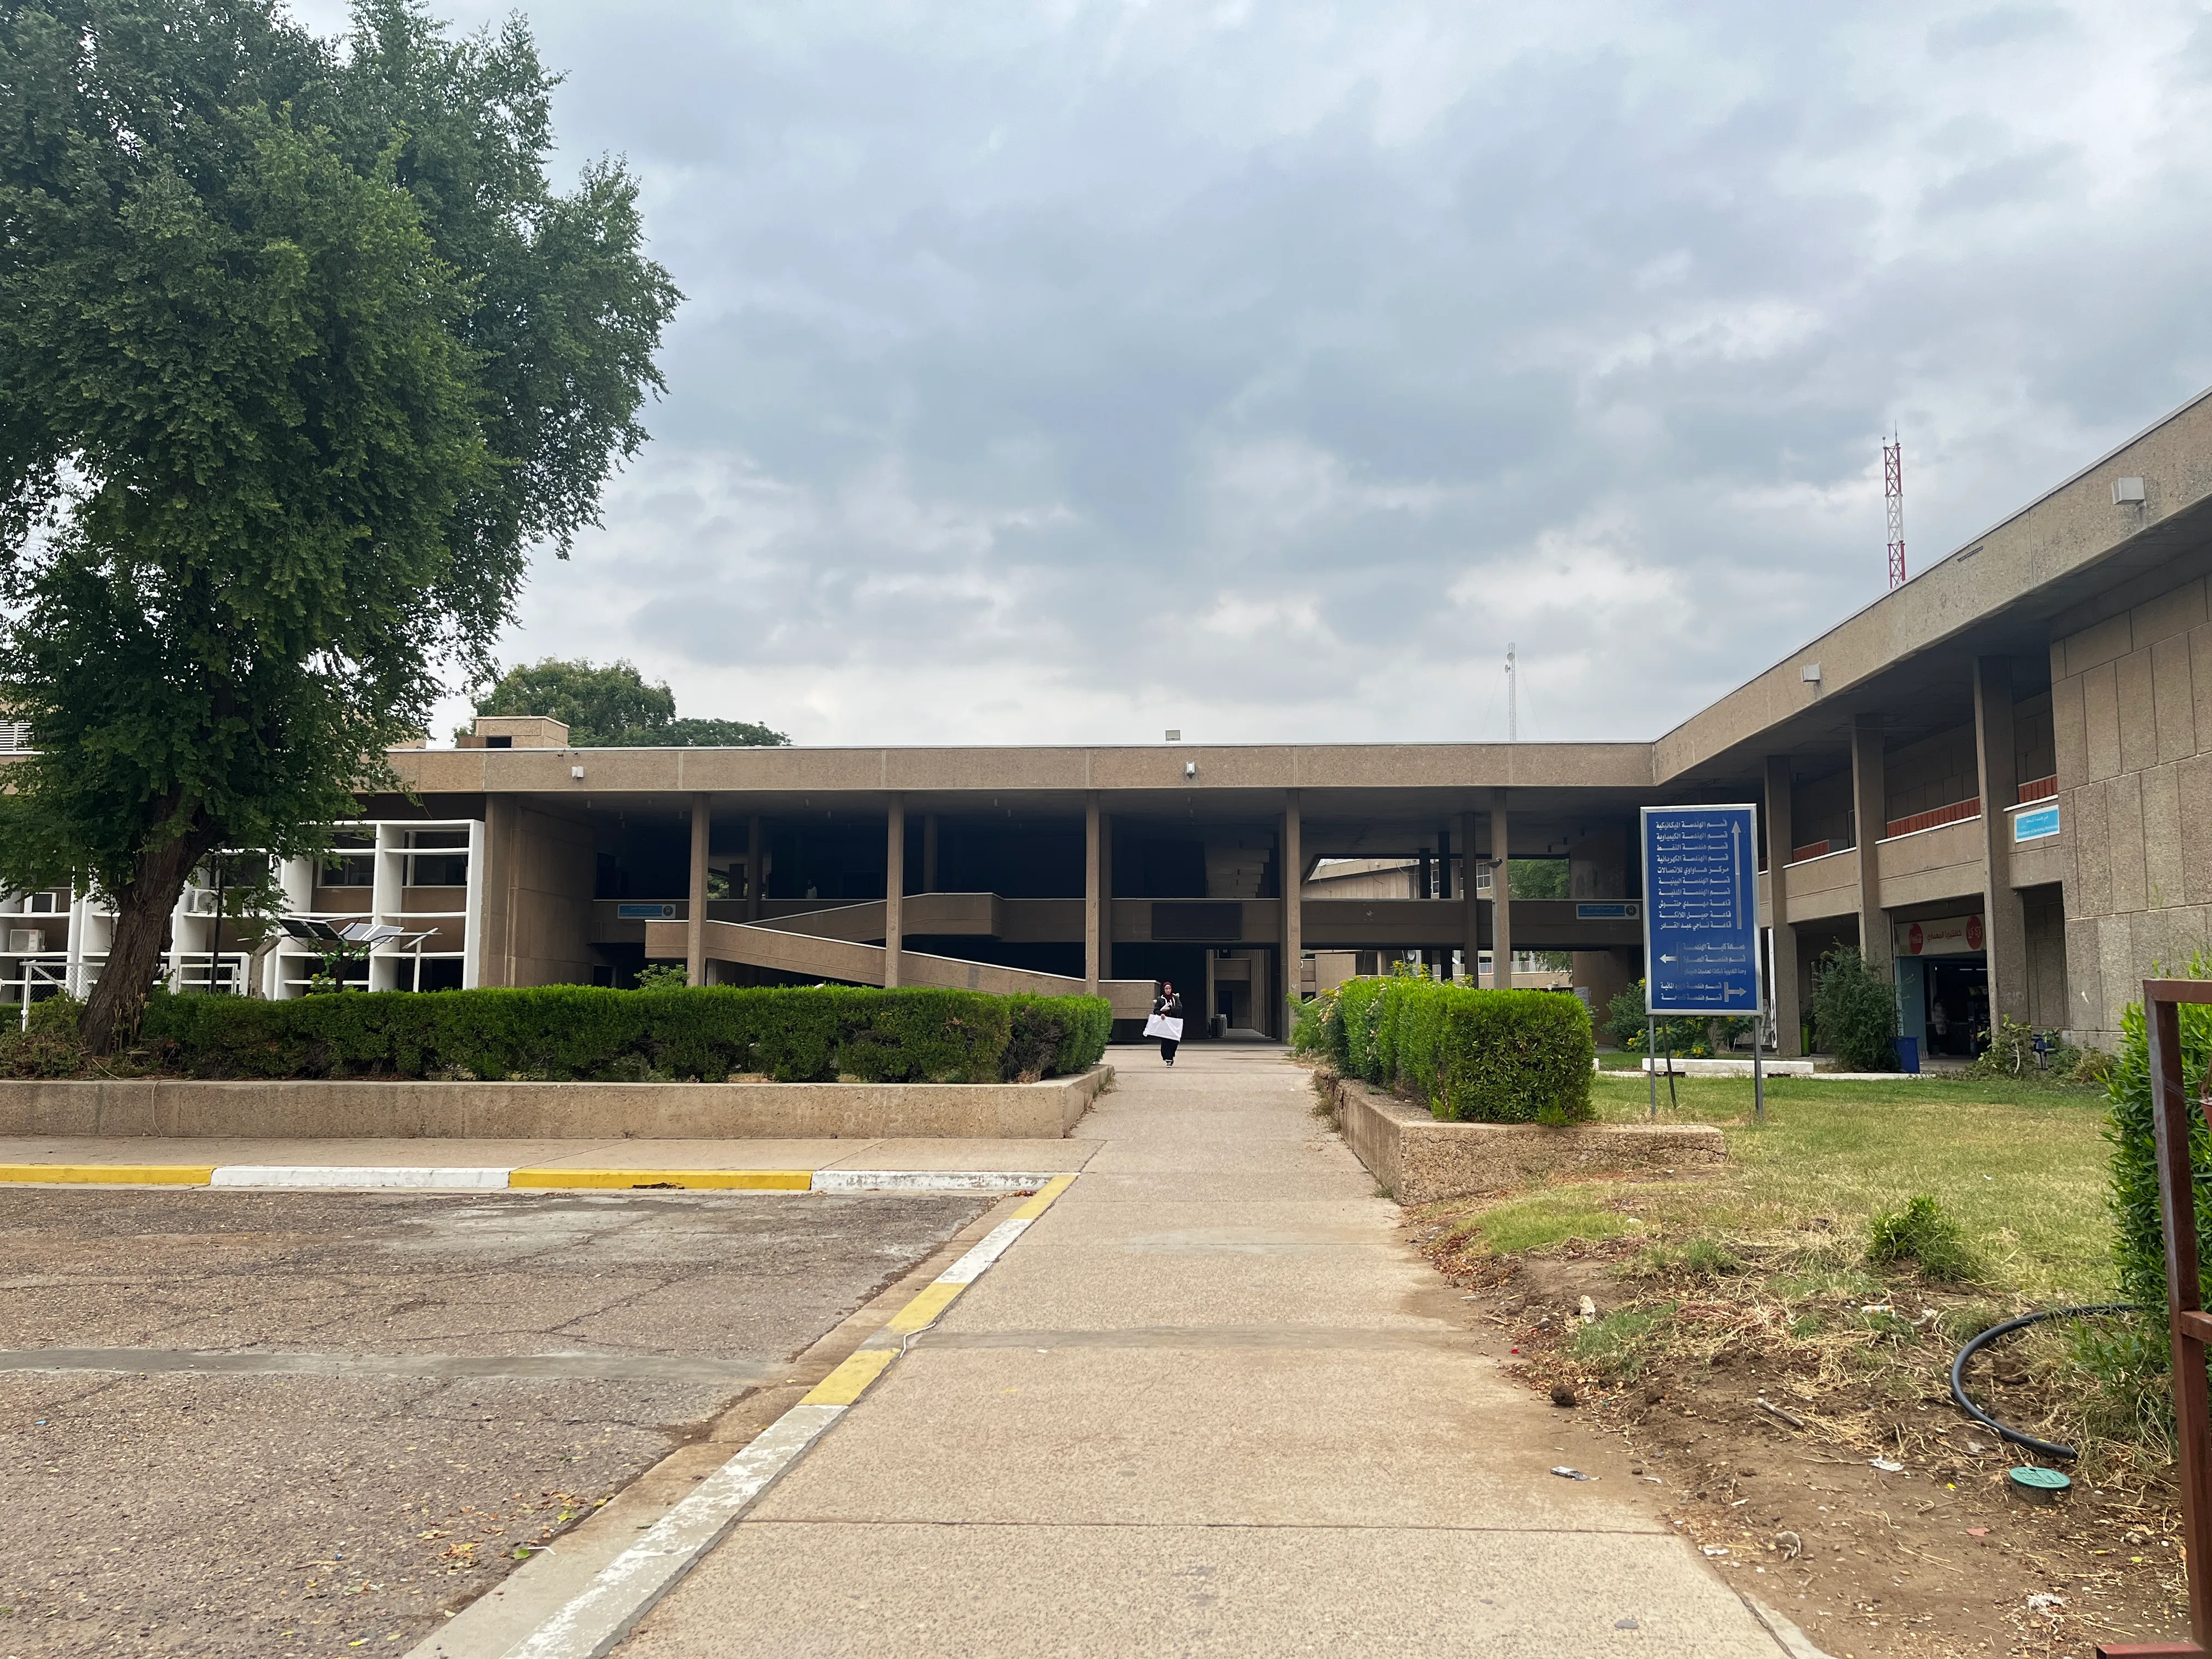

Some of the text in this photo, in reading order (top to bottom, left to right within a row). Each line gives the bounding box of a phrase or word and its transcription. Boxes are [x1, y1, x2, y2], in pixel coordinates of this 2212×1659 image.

[1707, 819, 1728, 829] قسم
[1707, 831, 1728, 839] قسم
[1707, 842, 1728, 851] قسم
[1657, 854, 1729, 864] قسم الهندسة الكهربائية
[1684, 866, 1707, 875] هاواوي
[1708, 866, 1729, 874] مركز
[1683, 877, 1708, 885] الهندسة
[1709, 876, 1730, 885] قسم
[1658, 888, 1681, 897] المدنية
[1710, 888, 1730, 896] قسم
[1683, 901, 1709, 909] مهدي
[1683, 943, 1706, 951] الهندسة
[1707, 943, 1726, 952] كلية
[1729, 955, 1746, 963] قسم
[1705, 982, 1722, 990] قسم
[1705, 994, 1722, 1002] قسم
